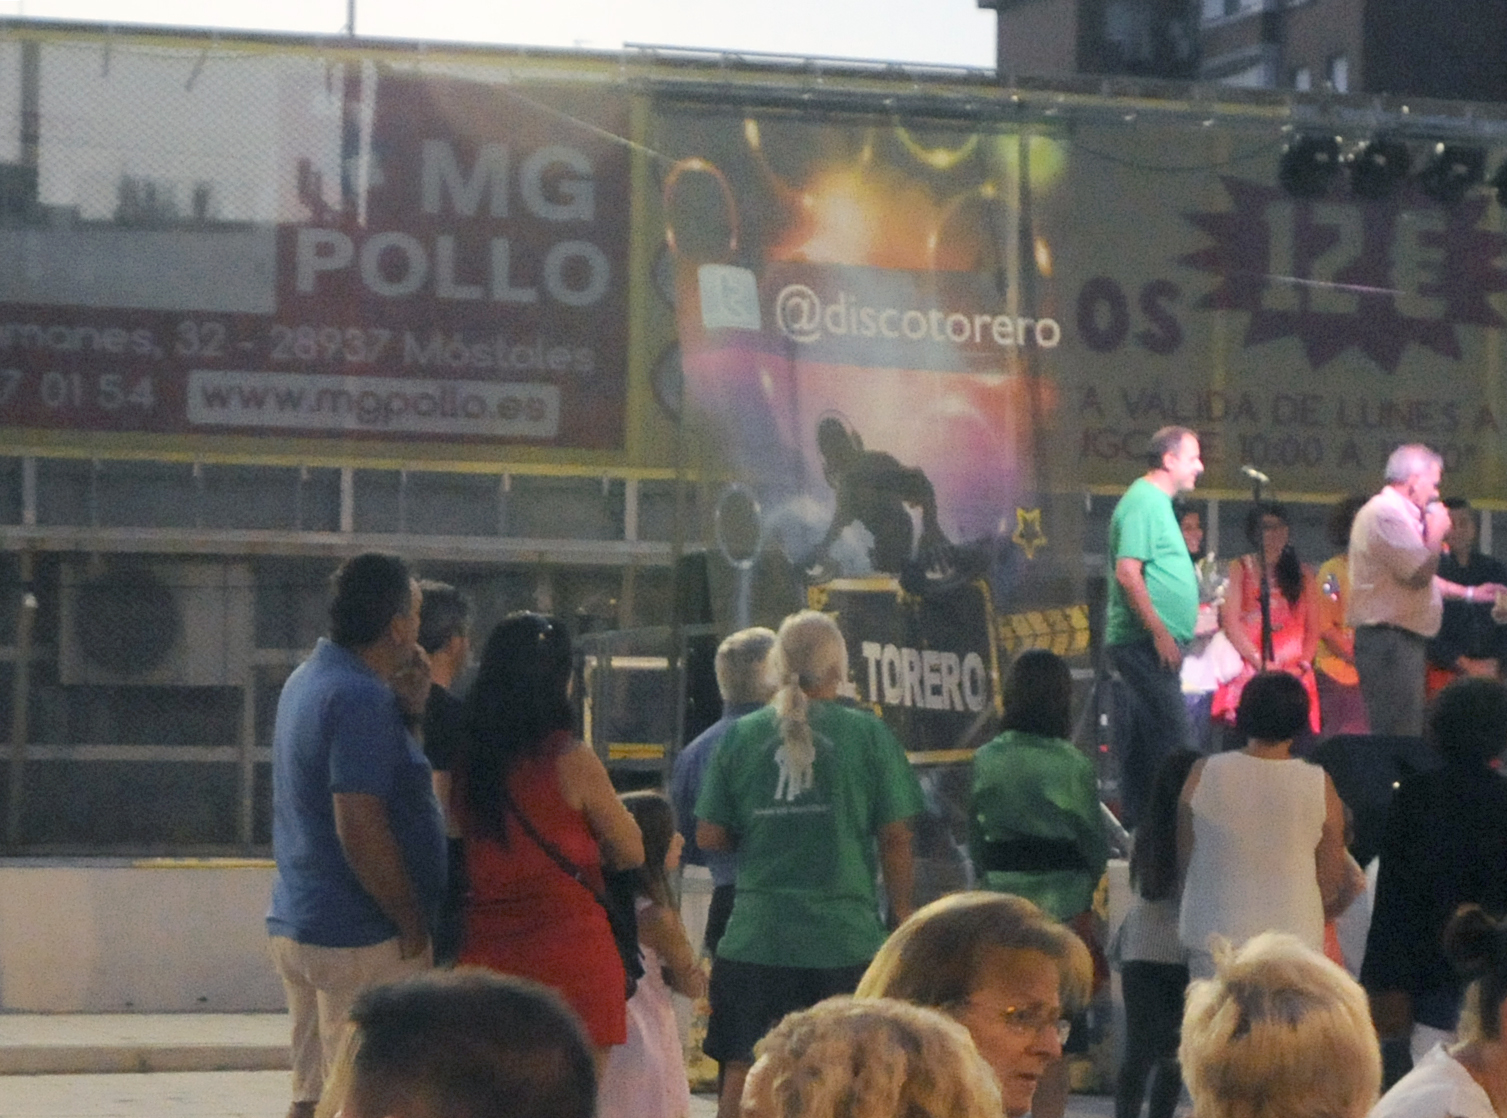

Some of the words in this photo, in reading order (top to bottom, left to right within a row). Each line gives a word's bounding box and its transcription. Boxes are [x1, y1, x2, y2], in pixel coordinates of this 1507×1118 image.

[420, 138, 597, 222] MG
[297, 228, 611, 306] POLLO
[0, 321, 163, 360] manes,
[174, 319, 227, 357] 32
[269, 325, 390, 365] 28937
[775, 283, 1061, 350] @discotorero
[98, 372, 157, 411] 54
[200, 380, 547, 425] www.mgpollo.es
[1271, 392, 1311, 428] DE
[1337, 396, 1459, 434] LUNES
[862, 640, 986, 712] TORERO
